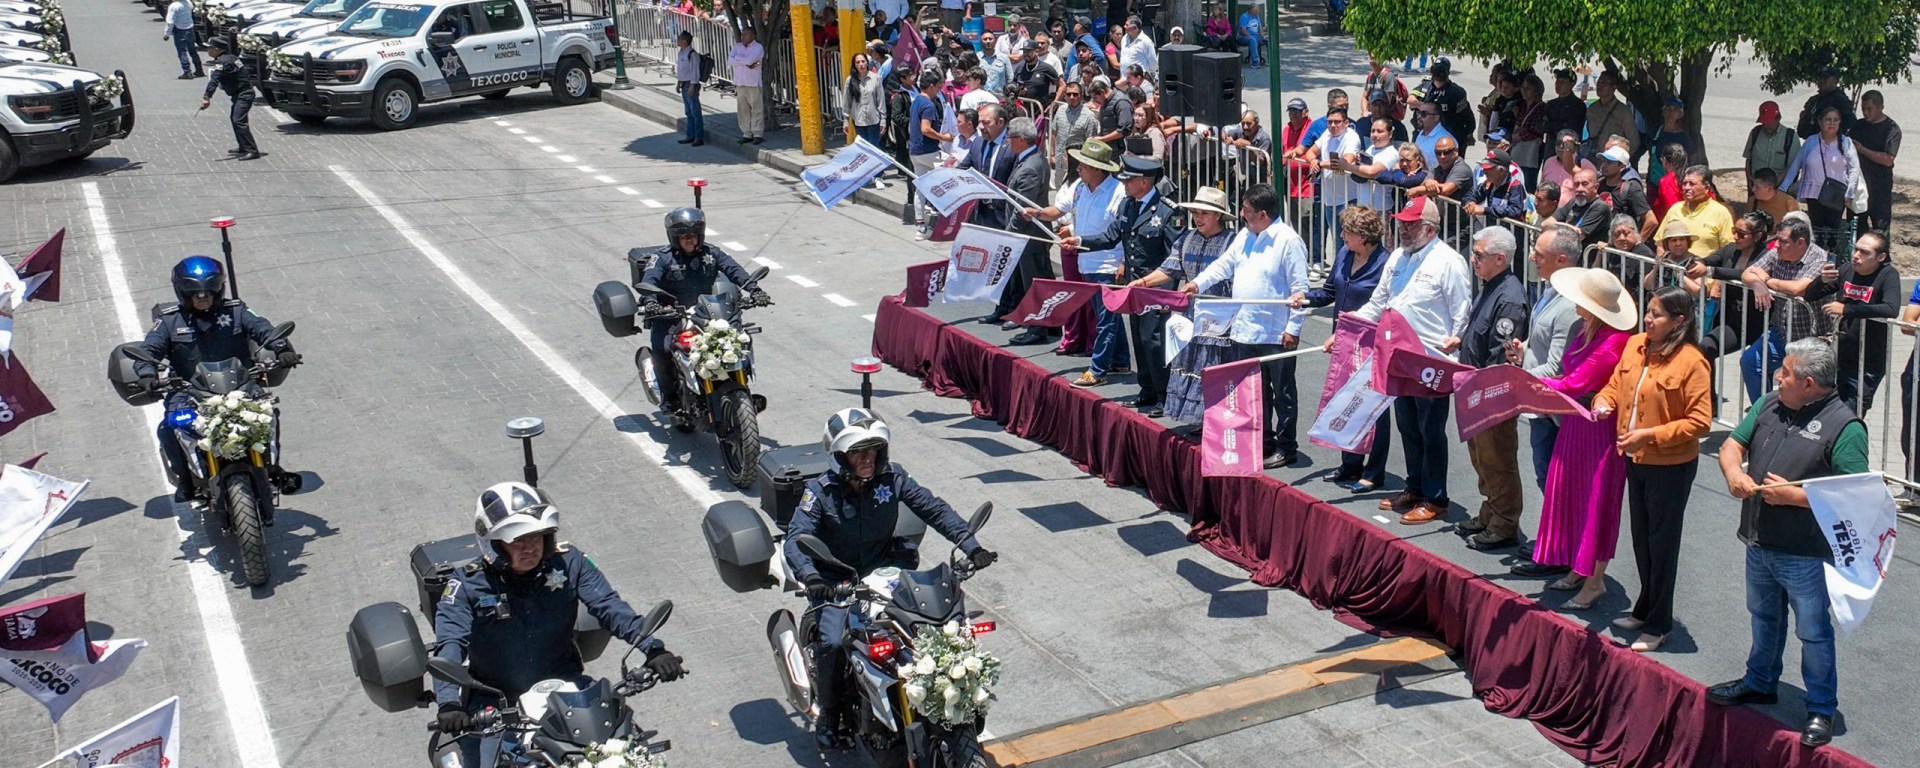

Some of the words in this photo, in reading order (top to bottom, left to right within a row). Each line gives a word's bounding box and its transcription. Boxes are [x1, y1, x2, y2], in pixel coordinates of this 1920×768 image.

[494, 50, 521, 60] MUNICIPAL
[470, 70, 528, 87] TEXCOCO
[985, 251, 1001, 287] GOBIERNO
[991, 246, 1012, 286] TEXCOCO
[65, 674, 80, 687] DE
